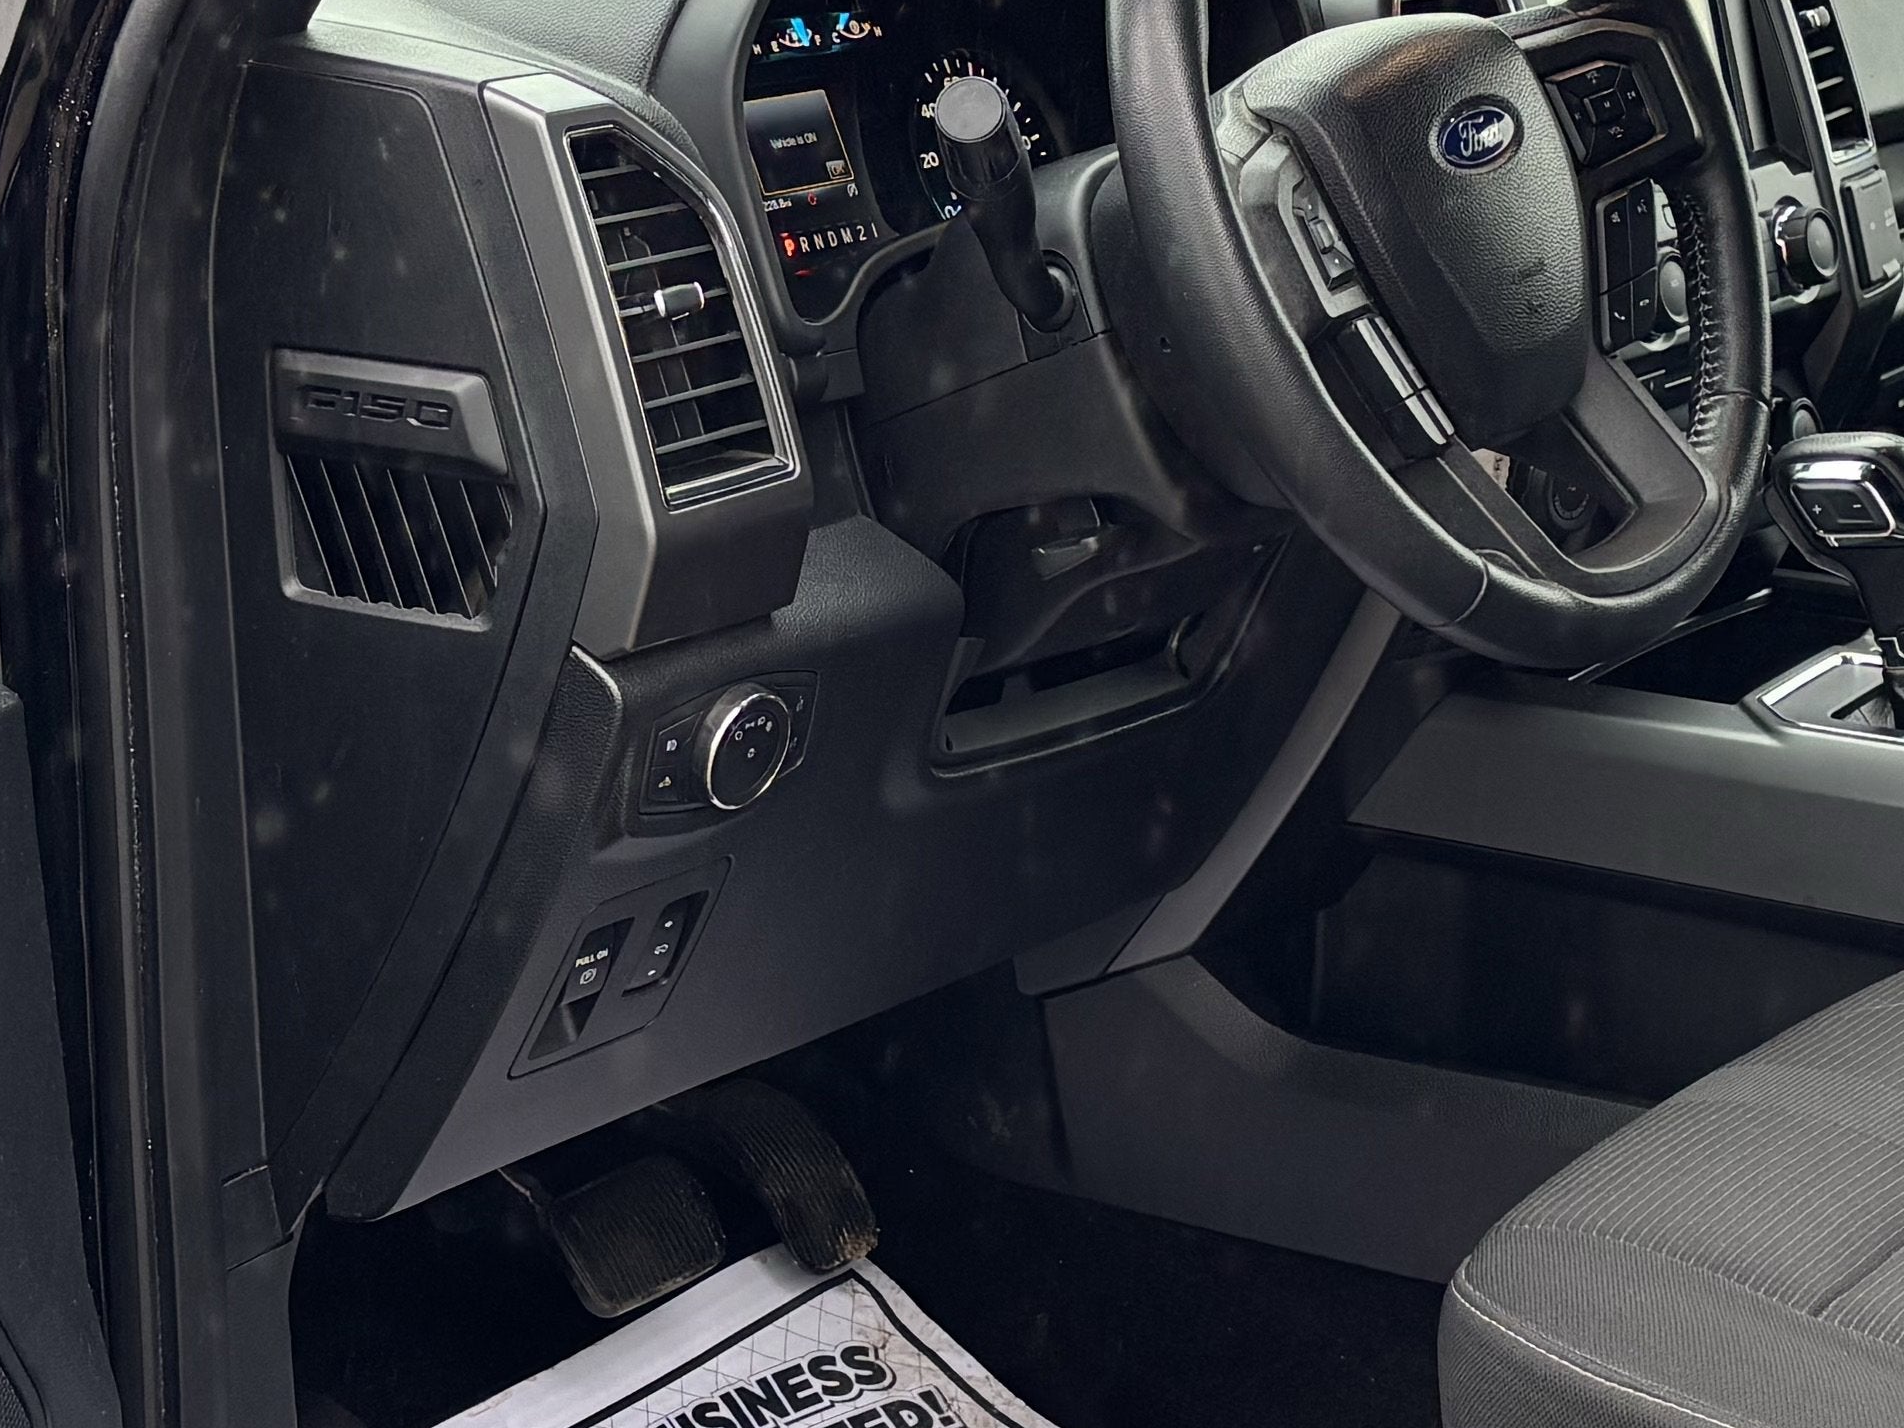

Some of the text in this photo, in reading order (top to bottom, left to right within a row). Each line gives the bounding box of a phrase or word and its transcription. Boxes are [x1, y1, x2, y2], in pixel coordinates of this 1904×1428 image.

[1458, 115, 1503, 158] Ford
[919, 151, 940, 170] 20
[799, 236, 811, 253] R
[813, 233, 825, 250] N
[827, 230, 838, 248] D
[840, 227, 854, 244] M
[856, 225, 867, 241] 2
[575, 954, 595, 968] PULL
